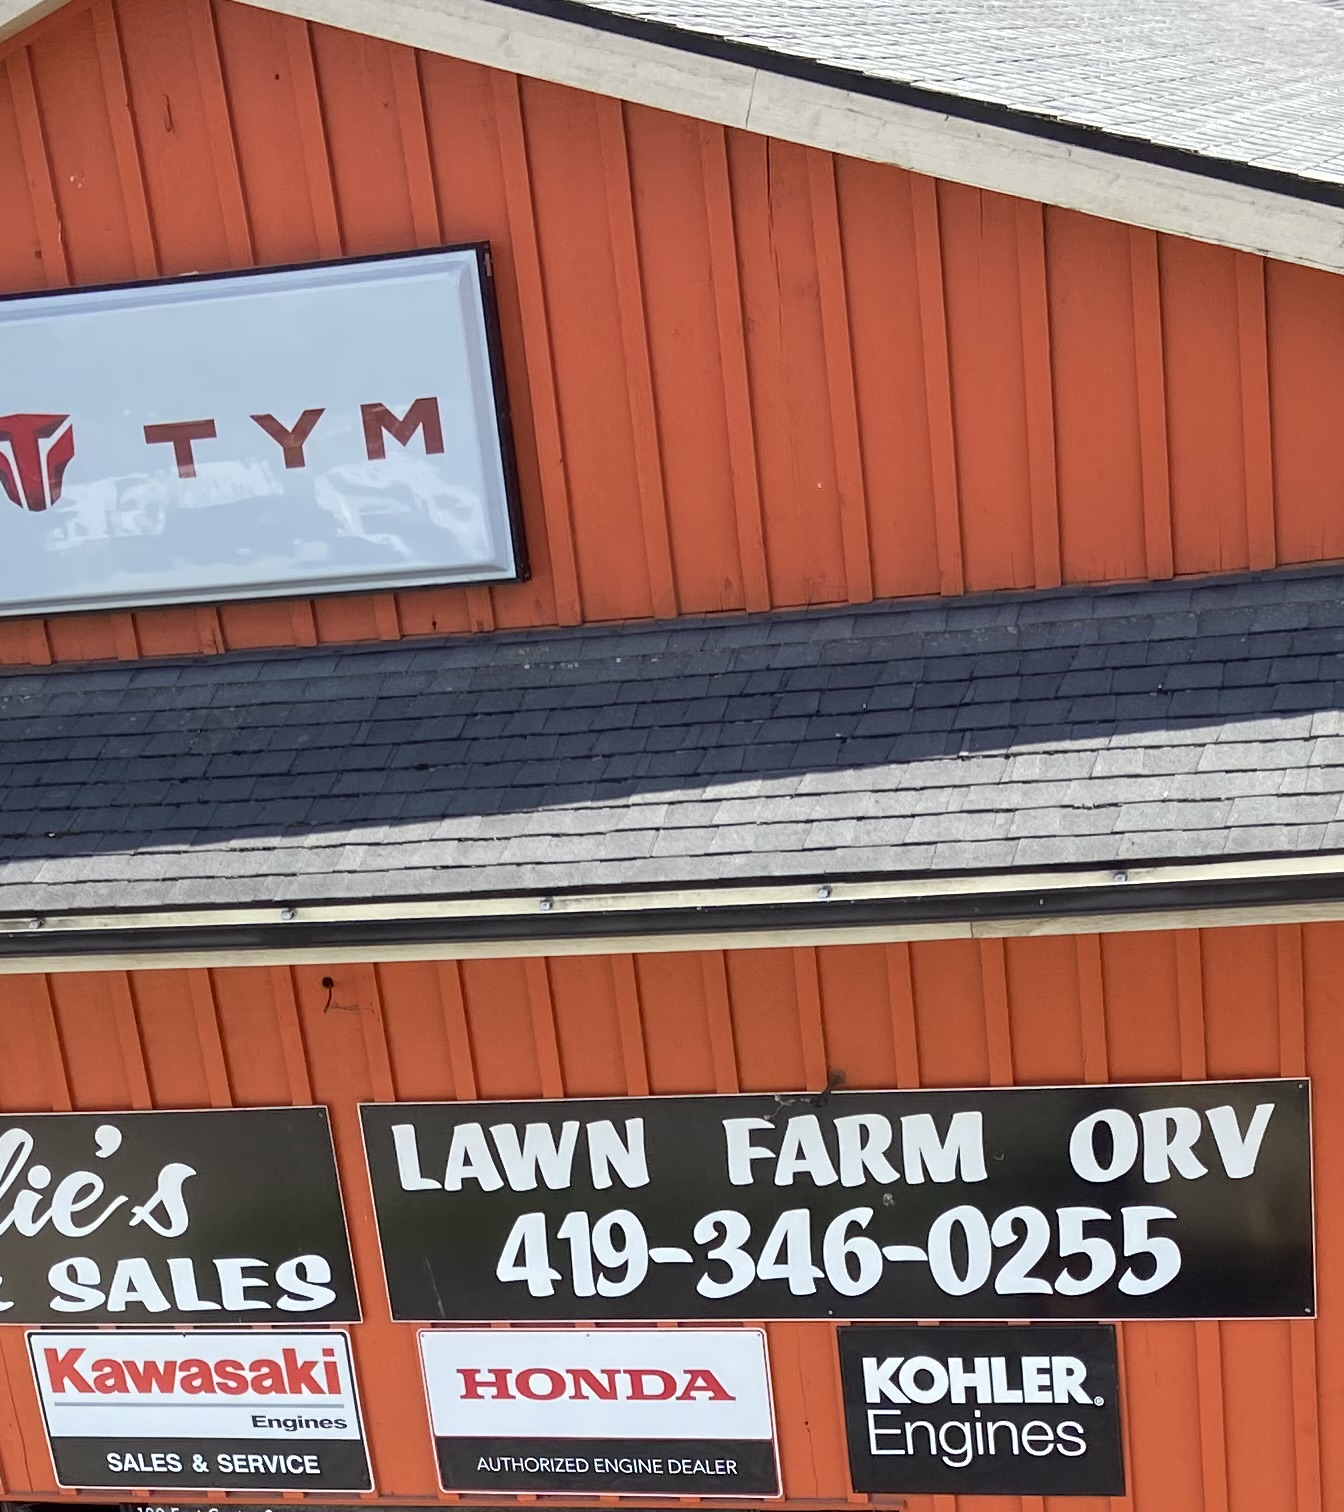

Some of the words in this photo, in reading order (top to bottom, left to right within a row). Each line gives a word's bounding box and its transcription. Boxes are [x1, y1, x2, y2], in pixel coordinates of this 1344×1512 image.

[143, 396, 445, 479] TYM
[390, 1116, 650, 1193] LAWN
[723, 1110, 988, 1188] FARM
[1068, 1102, 1275, 1185] ORV
[495, 1204, 1183, 1300] 419-346-0255
[47, 1254, 338, 1313] SALES
[43, 1347, 342, 1395] Kawasaki
[456, 1367, 737, 1401] HONDA
[862, 1355, 1094, 1405] KOHLER
[251, 1415, 348, 1432] Engines
[867, 1408, 1087, 1468] Engines
[106, 1452, 183, 1473] SALES
[192, 1453, 209, 1473] &
[218, 1453, 321, 1475] SERVICE
[477, 1456, 589, 1474] AUTHORIZED
[594, 1458, 664, 1474] ENGINE
[668, 1459, 738, 1475] DEALER
